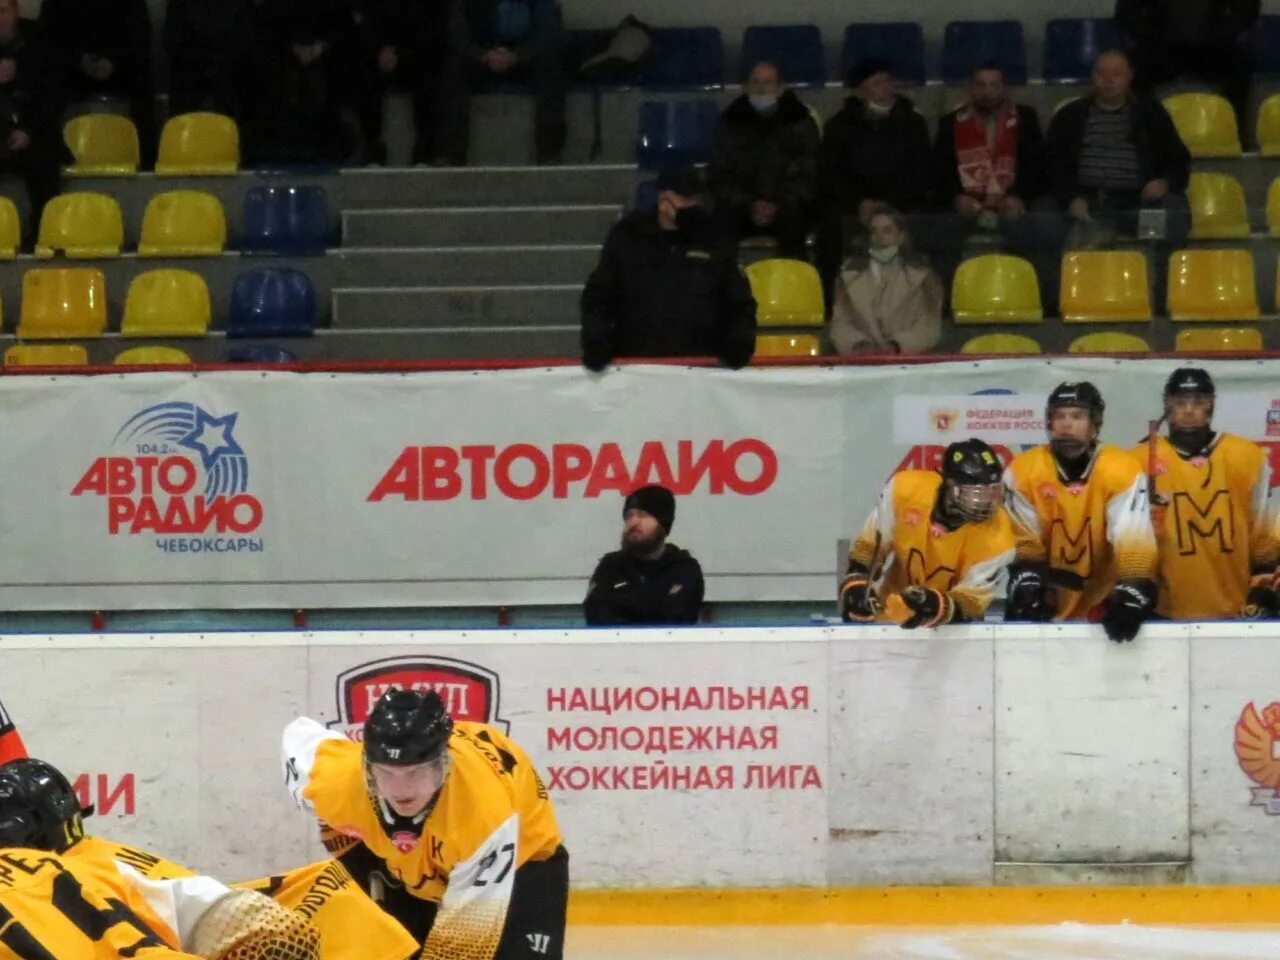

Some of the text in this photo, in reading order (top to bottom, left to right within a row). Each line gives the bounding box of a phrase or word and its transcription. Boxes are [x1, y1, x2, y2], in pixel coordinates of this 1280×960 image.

[70, 455, 196, 496] АВТО
[367, 438, 779, 502] АВТОРАДИО
[108, 494, 264, 534] РАДИО
[156, 538, 264, 553] ЧЕБОКСАРЫ
[546, 686, 810, 714] НАЦИОНАЛЬНАЯ
[547, 725, 778, 754] МОЛОДЕЖНАЯ
[546, 760, 734, 790] ХОККЕЙНАЯ
[743, 765, 823, 790] ЛИГА
[472, 843, 516, 887] 27
